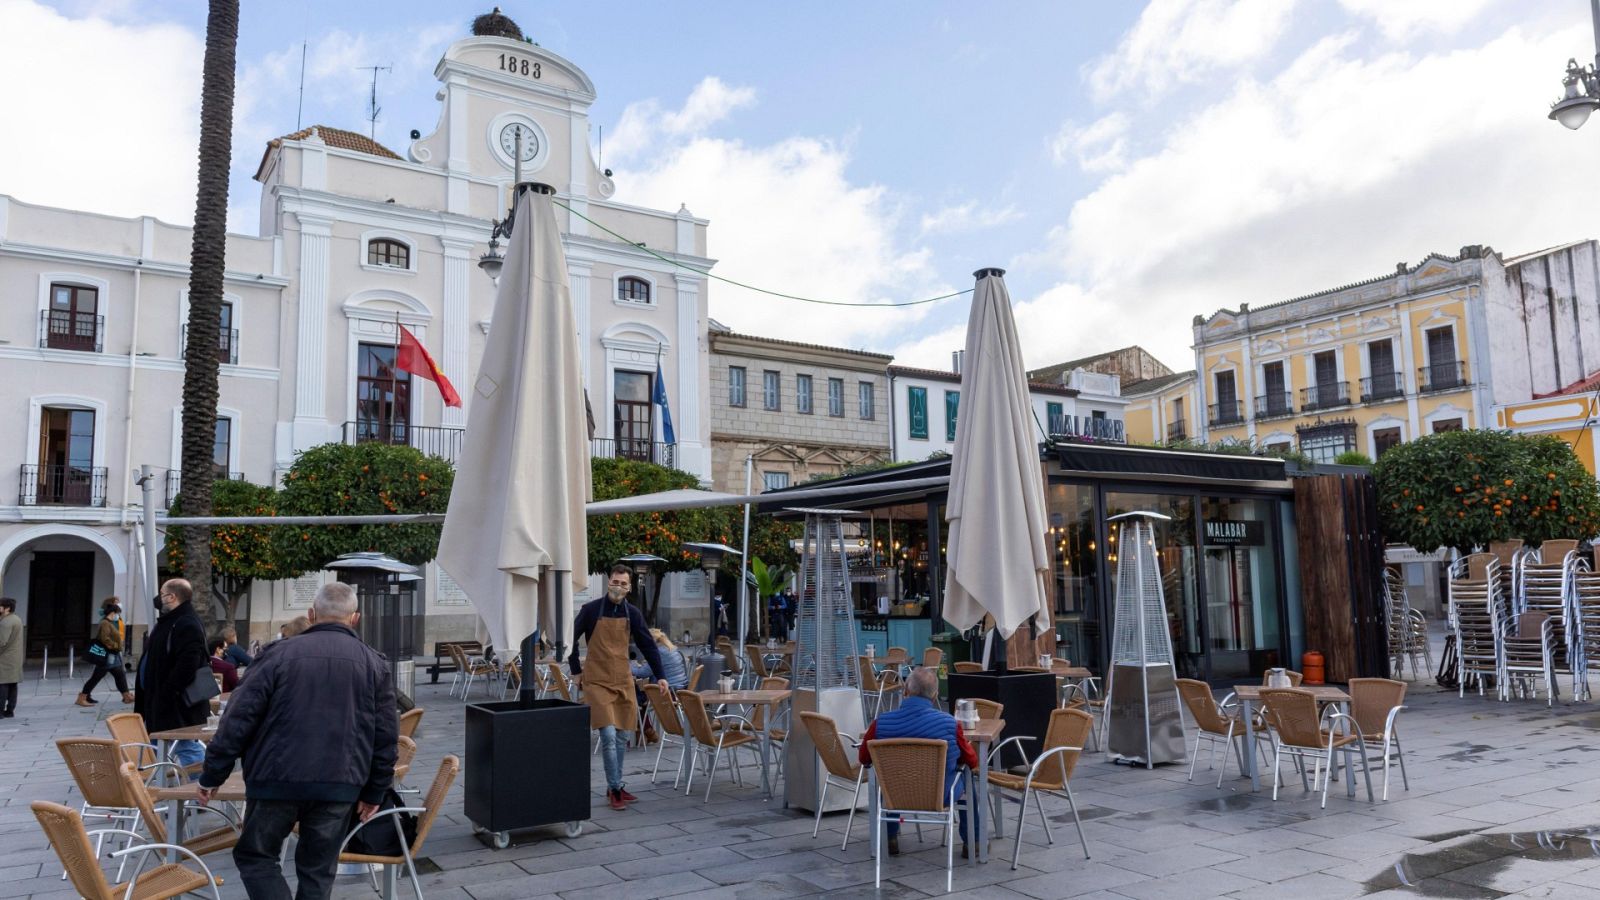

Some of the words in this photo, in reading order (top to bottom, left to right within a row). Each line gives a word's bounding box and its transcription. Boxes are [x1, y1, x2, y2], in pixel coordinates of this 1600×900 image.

[498, 53, 541, 79] 1883
[1050, 413, 1125, 442] MALABAR
[1207, 522, 1247, 538] MALABAR
